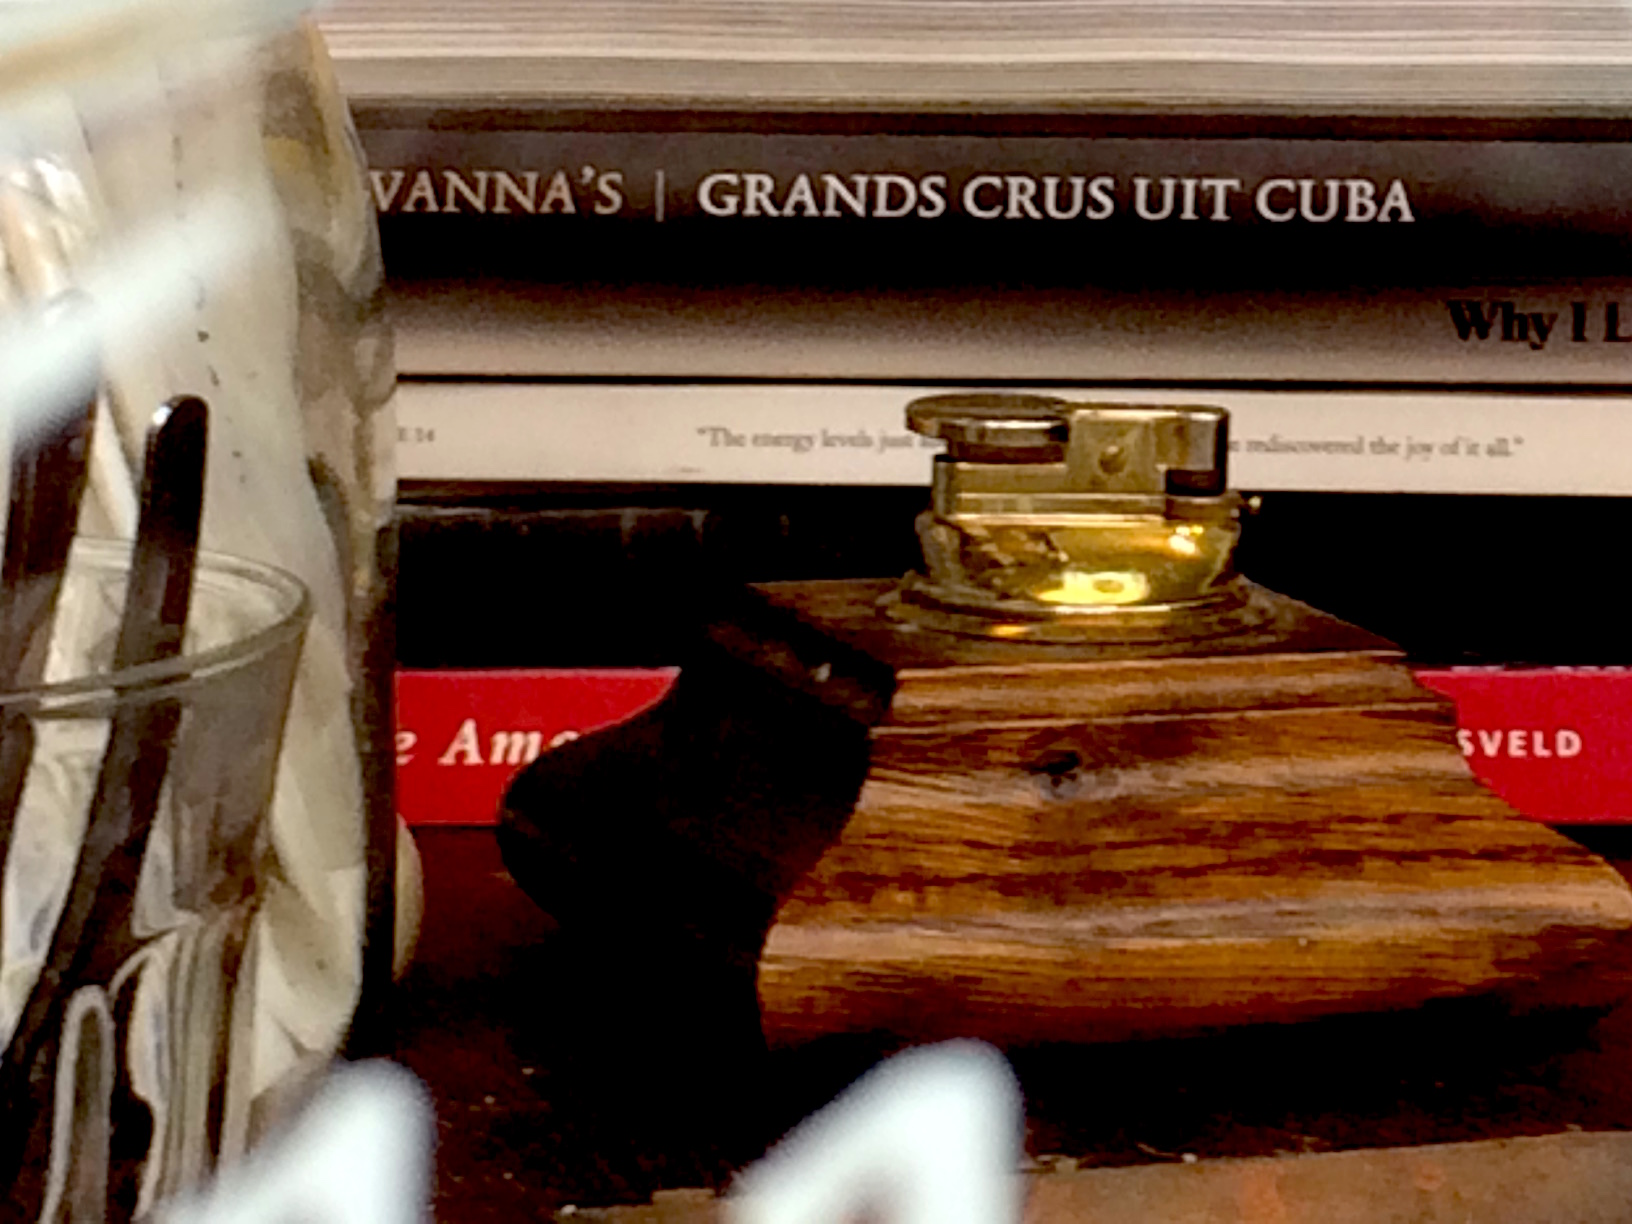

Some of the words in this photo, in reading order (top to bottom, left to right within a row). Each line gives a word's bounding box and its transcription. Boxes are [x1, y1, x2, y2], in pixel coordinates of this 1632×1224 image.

[369, 164, 624, 214] VANNA'S
[699, 173, 946, 220] GRANDS
[962, 174, 1117, 222] CRUS
[1133, 176, 1241, 222] UIT
[1255, 177, 1416, 225] CUBA
[1446, 299, 1558, 351] Why
[1571, 301, 1589, 343] I
[1457, 728, 1583, 760] SVELD
